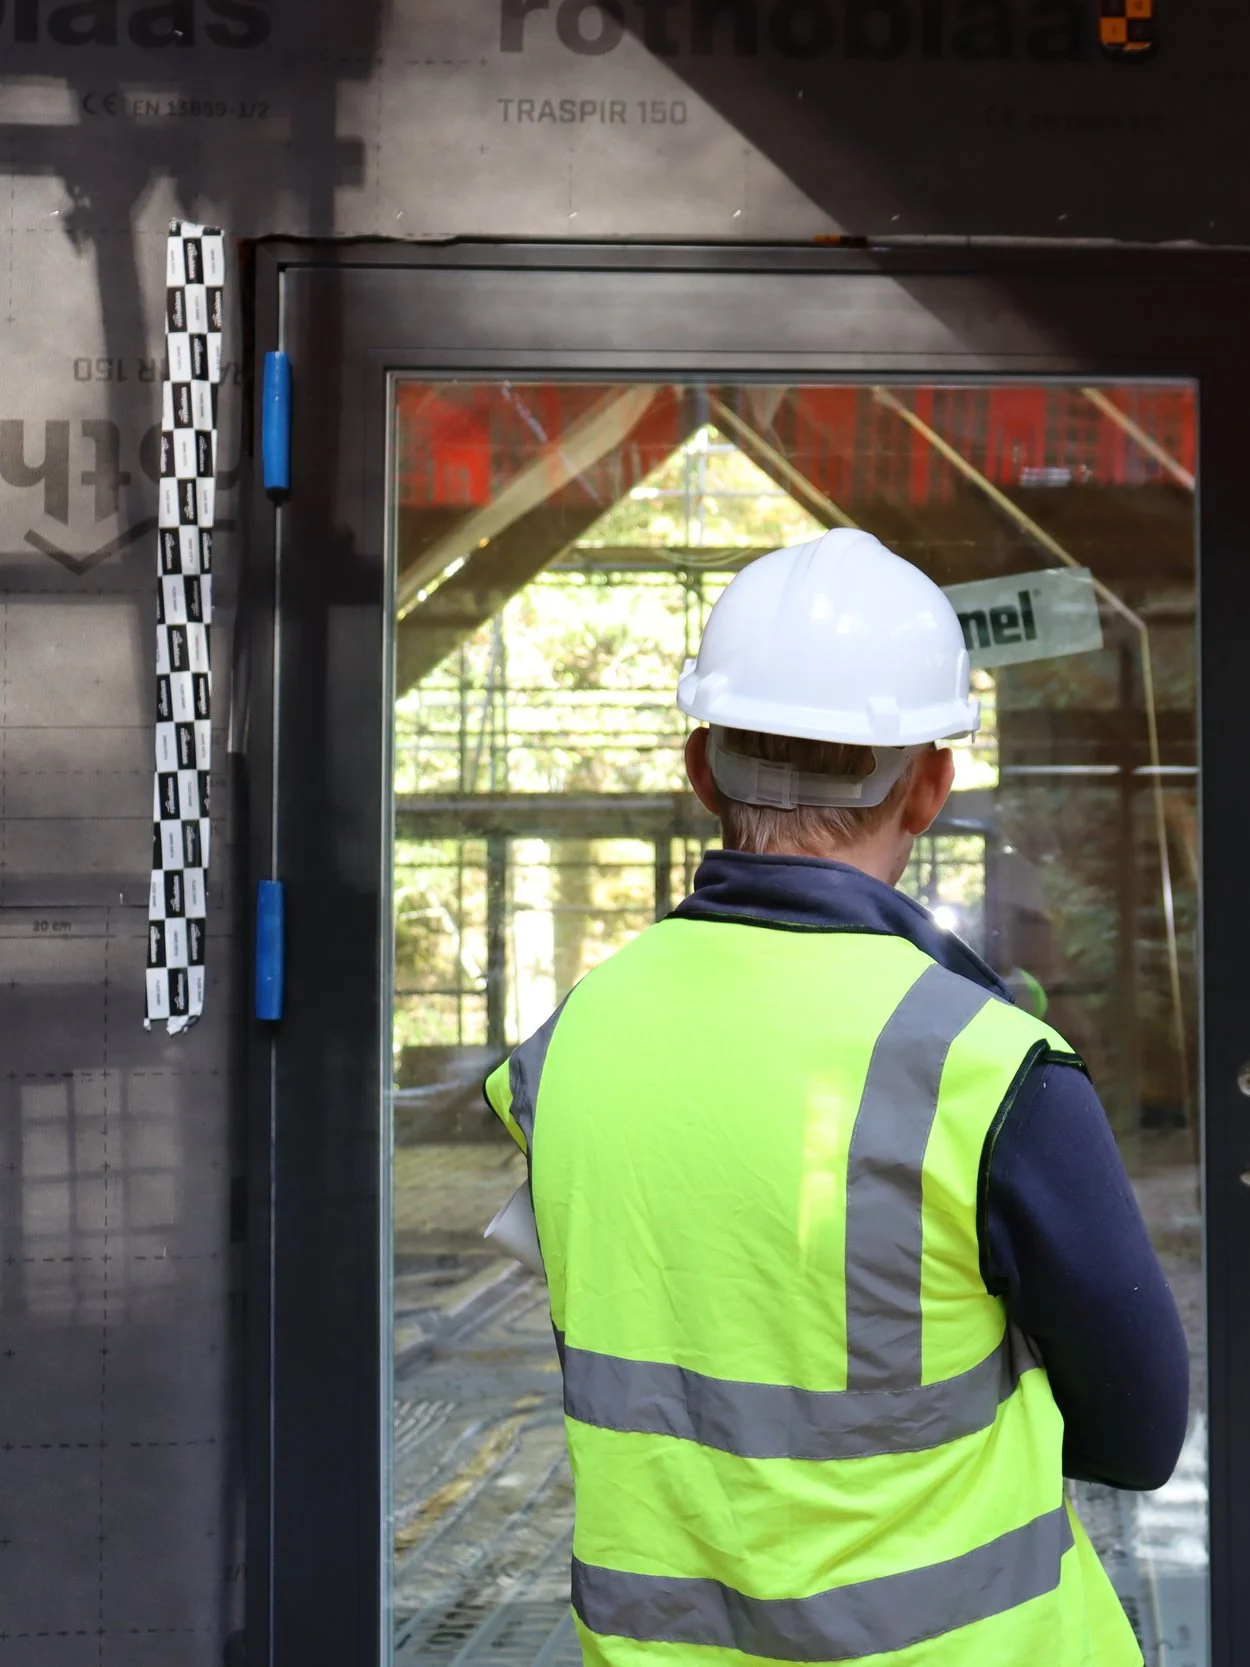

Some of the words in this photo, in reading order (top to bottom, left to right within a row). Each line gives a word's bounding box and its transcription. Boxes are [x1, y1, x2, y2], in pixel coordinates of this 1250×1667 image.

[498, 0, 1159, 64] rothoblaa
[497, 98, 627, 124] TRASPIR
[637, 100, 688, 125] 150
